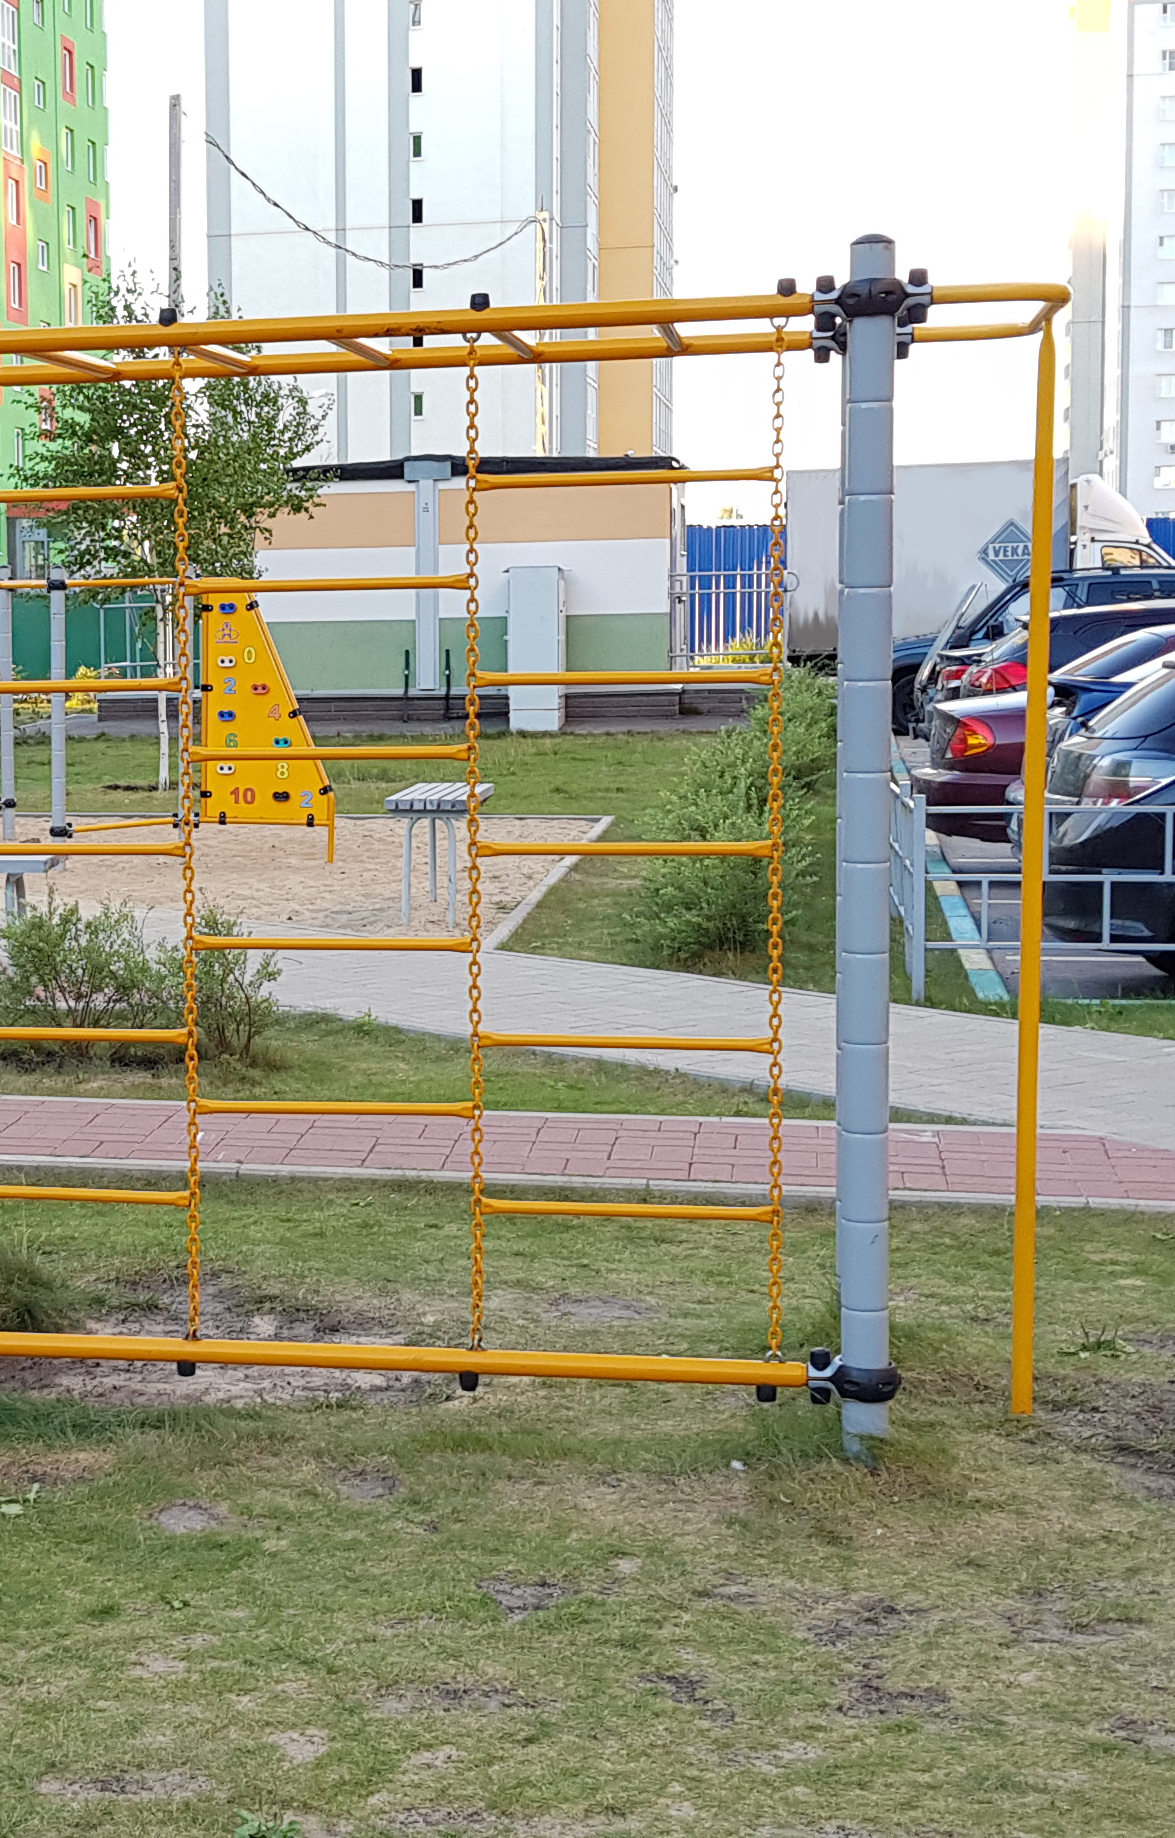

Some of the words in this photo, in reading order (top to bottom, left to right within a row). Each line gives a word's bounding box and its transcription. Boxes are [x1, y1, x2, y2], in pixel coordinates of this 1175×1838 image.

[992, 544, 1032, 558] VEKA
[223, 677, 237, 694] 2
[267, 703, 282, 721] 4
[225, 733, 238, 748] 6
[276, 762, 289, 779] 8
[230, 787, 256, 804] 10
[299, 790, 314, 808] 2
